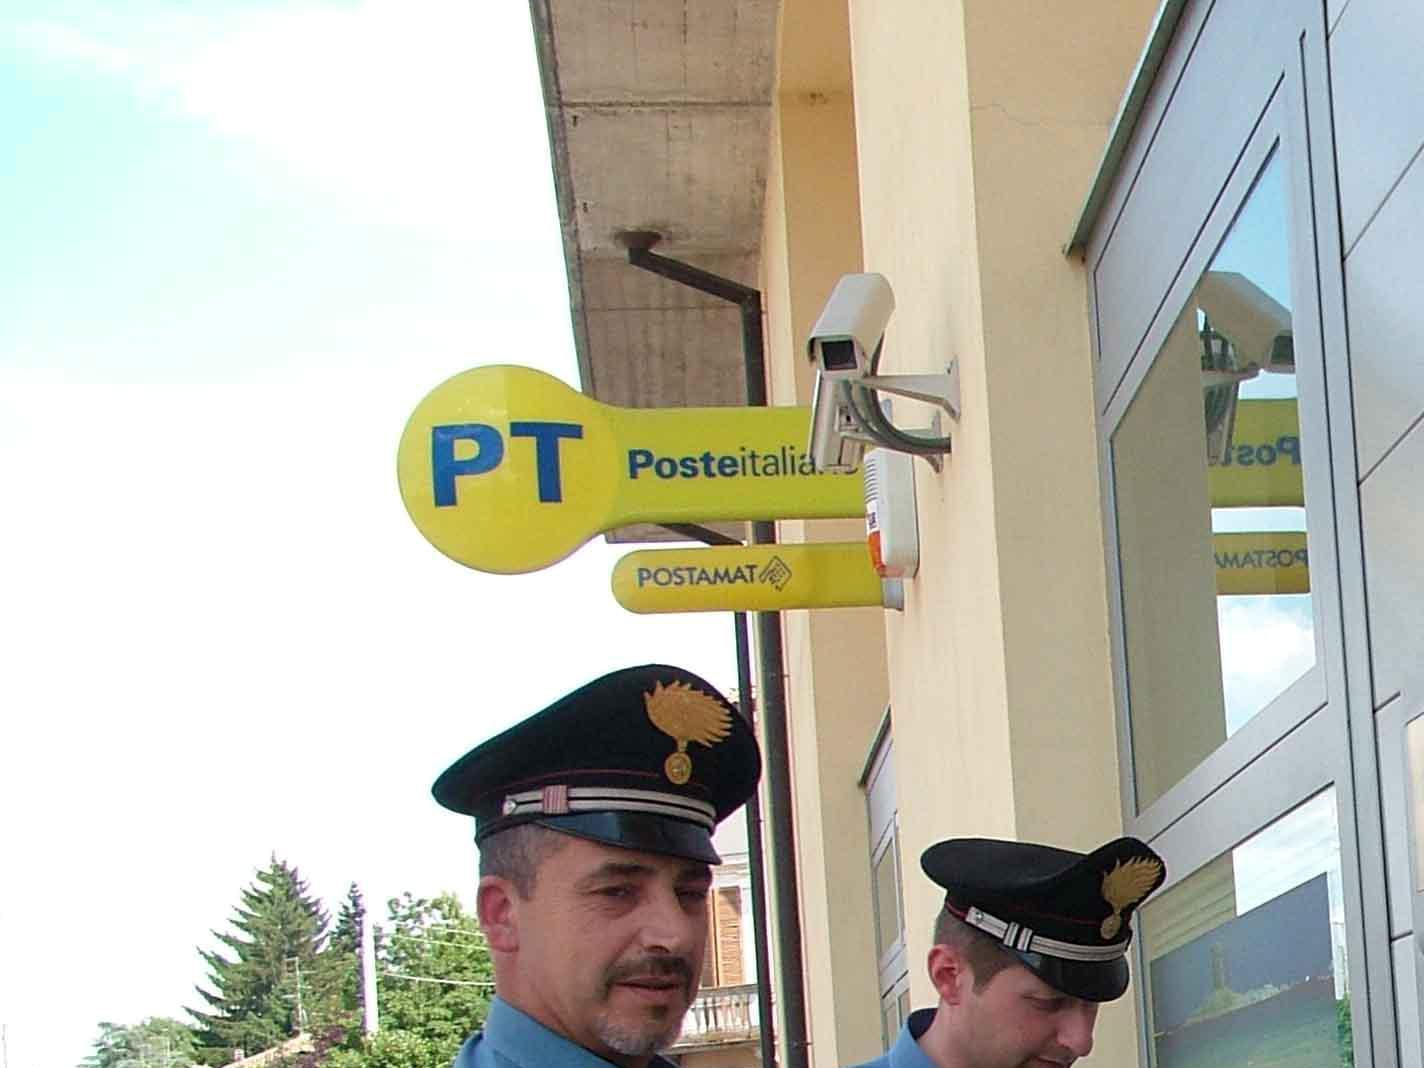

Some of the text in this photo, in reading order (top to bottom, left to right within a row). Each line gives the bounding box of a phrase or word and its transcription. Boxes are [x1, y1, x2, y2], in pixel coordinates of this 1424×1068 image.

[432, 421, 583, 508] PT
[628, 446, 858, 480] Posteitalia
[637, 563, 758, 588] POSTAMAT
